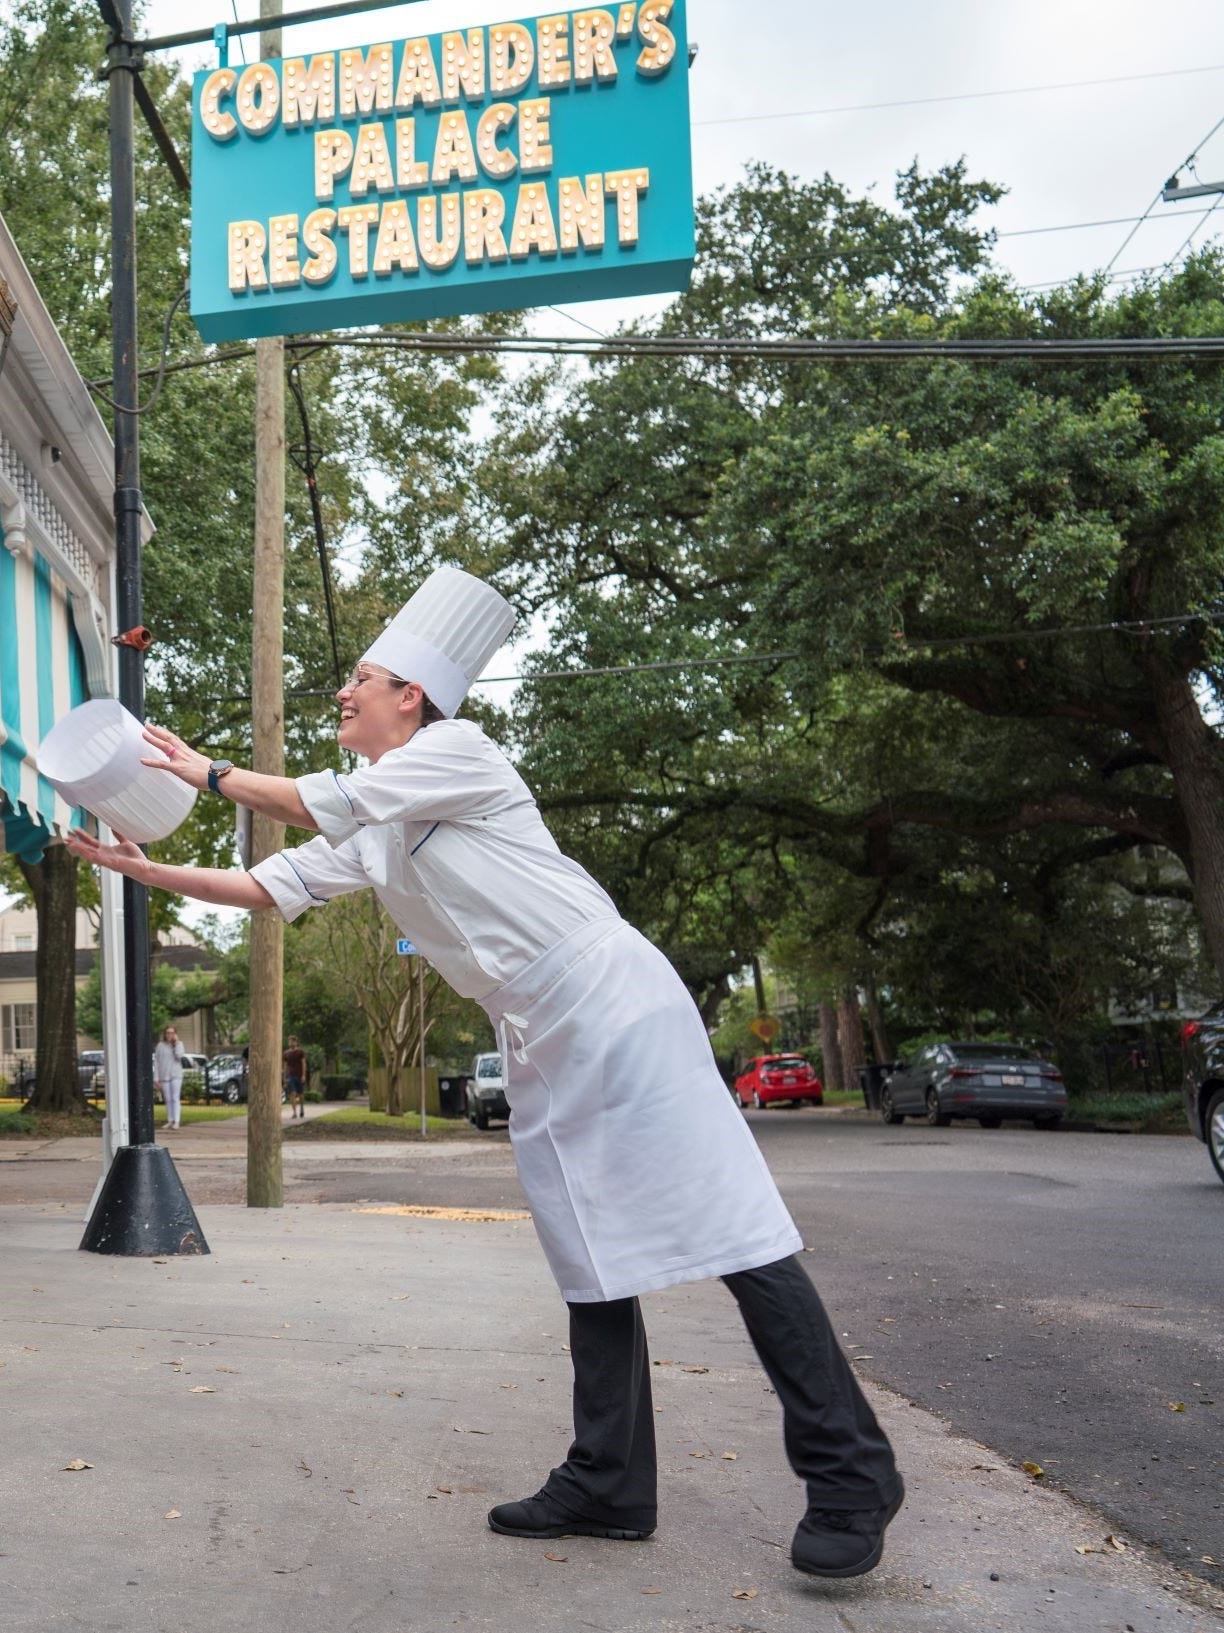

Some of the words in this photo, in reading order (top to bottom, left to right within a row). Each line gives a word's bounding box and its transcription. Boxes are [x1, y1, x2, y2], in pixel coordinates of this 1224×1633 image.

[200, 0, 676, 141] COMMANDER'S
[313, 96, 553, 202] PALACE
[227, 167, 649, 294] RESTAURANT
